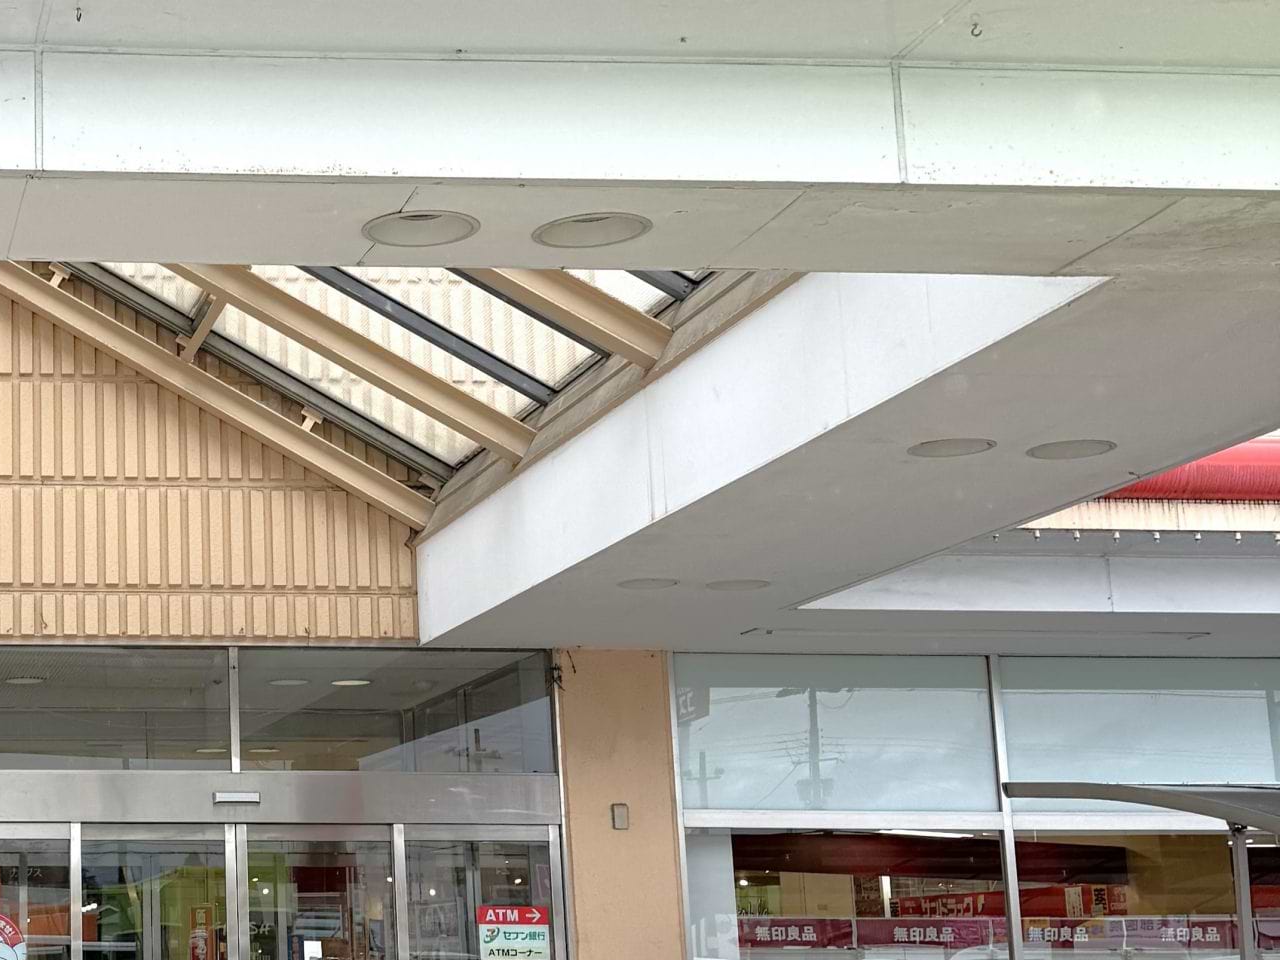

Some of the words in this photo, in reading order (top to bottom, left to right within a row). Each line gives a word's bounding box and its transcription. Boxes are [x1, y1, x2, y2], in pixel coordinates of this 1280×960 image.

[486, 910, 519, 922] ATM
[503, 930, 546, 941] セブン銀行
[755, 926, 817, 942] 無印良品
[893, 926, 955, 942] 無印良品
[1028, 926, 1089, 942] 無印良品
[1160, 926, 1220, 942] 無印良品
[488, 948, 543, 957] ATMコーナー
